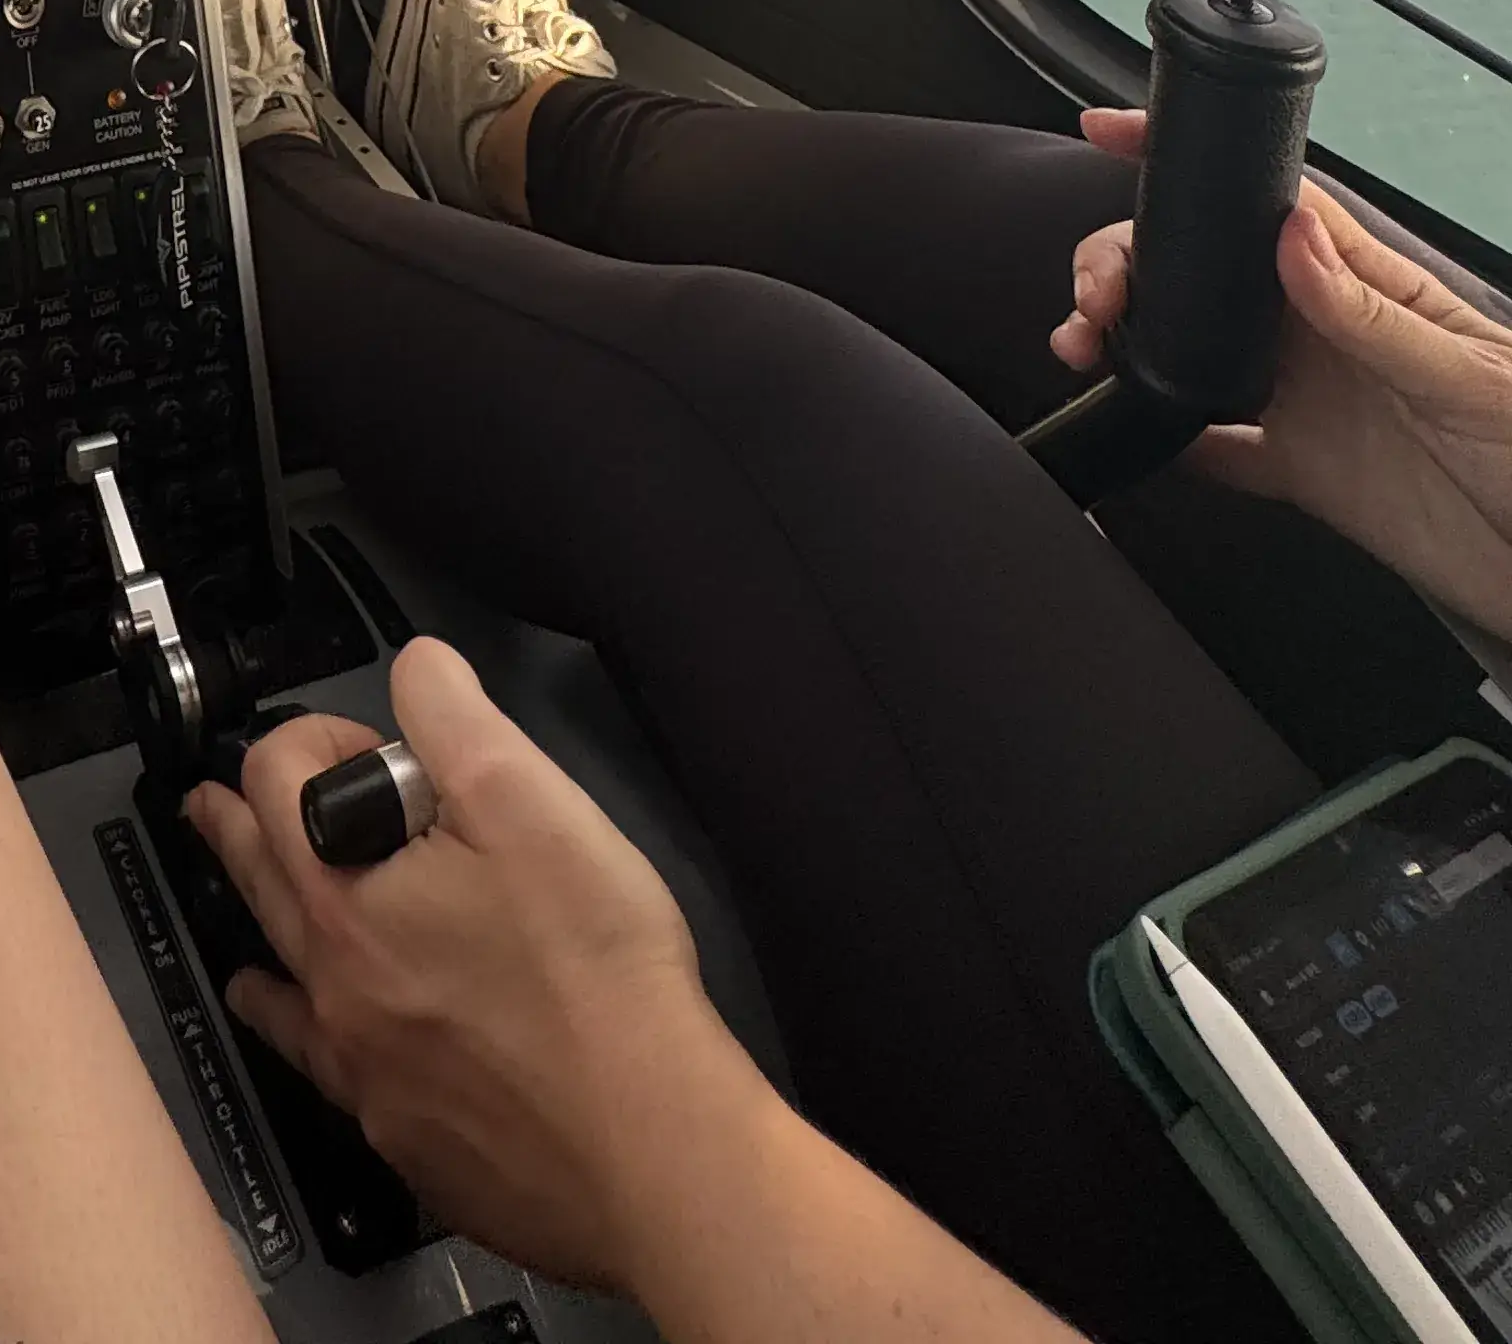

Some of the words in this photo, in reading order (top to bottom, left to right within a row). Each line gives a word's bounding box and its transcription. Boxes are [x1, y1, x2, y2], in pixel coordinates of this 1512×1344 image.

[16, 36, 39, 49] OFF
[35, 116, 52, 133] 25
[93, 110, 142, 129] BATTERY
[95, 125, 143, 144] CAUTION
[26, 139, 50, 154] GEN
[11, 182, 23, 190] DO
[23, 179, 38, 189] NOT
[39, 173, 60, 185] LEAVE
[61, 168, 82, 180] DOOR
[82, 164, 101, 176] OPEN
[171, 176, 194, 310] PIPISTREL
[92, 289, 116, 303] LDG
[40, 297, 70, 314] FUEL
[90, 301, 122, 318] LIGHT
[40, 313, 72, 330] PUMP
[154, 951, 175, 969] ON
[193, 1042, 266, 1211] THROTTLE
[261, 1228, 290, 1257] IDLE
